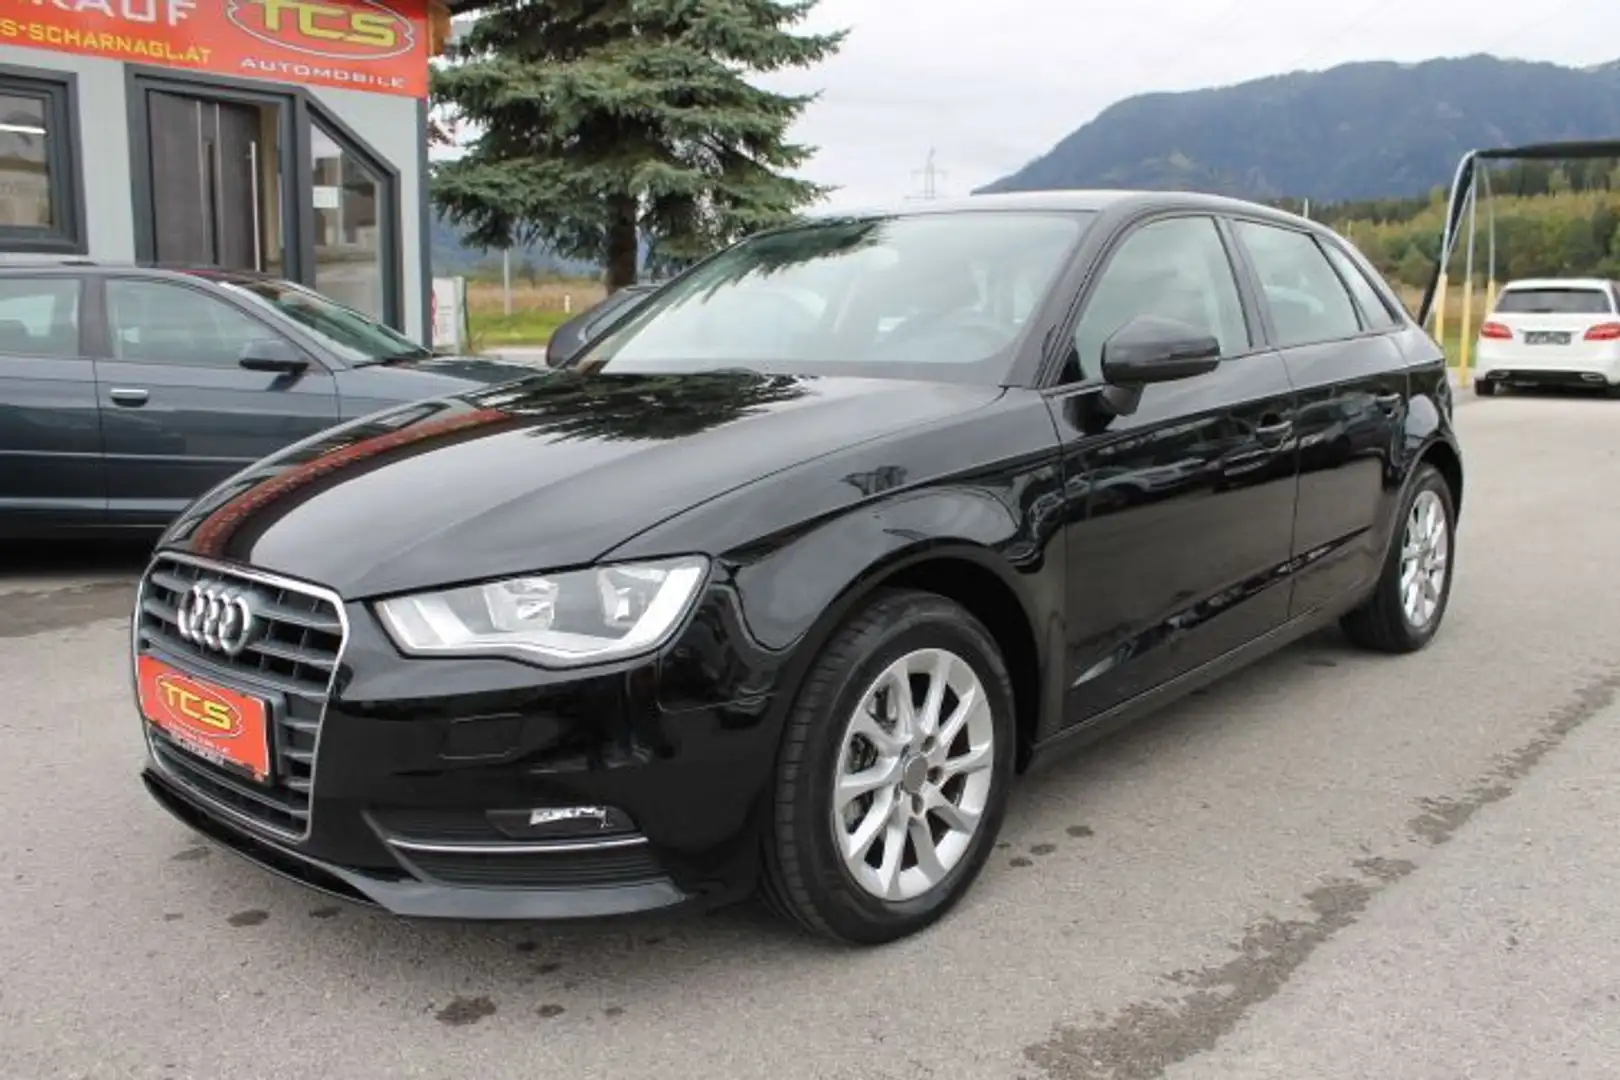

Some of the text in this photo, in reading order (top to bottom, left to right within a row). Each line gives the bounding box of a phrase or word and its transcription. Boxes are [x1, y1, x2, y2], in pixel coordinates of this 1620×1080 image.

[31, 0, 197, 26] AUF
[258, 0, 397, 47] TCS
[241, 57, 405, 88] AUTOMOBILE
[160, 681, 231, 730] TCS
